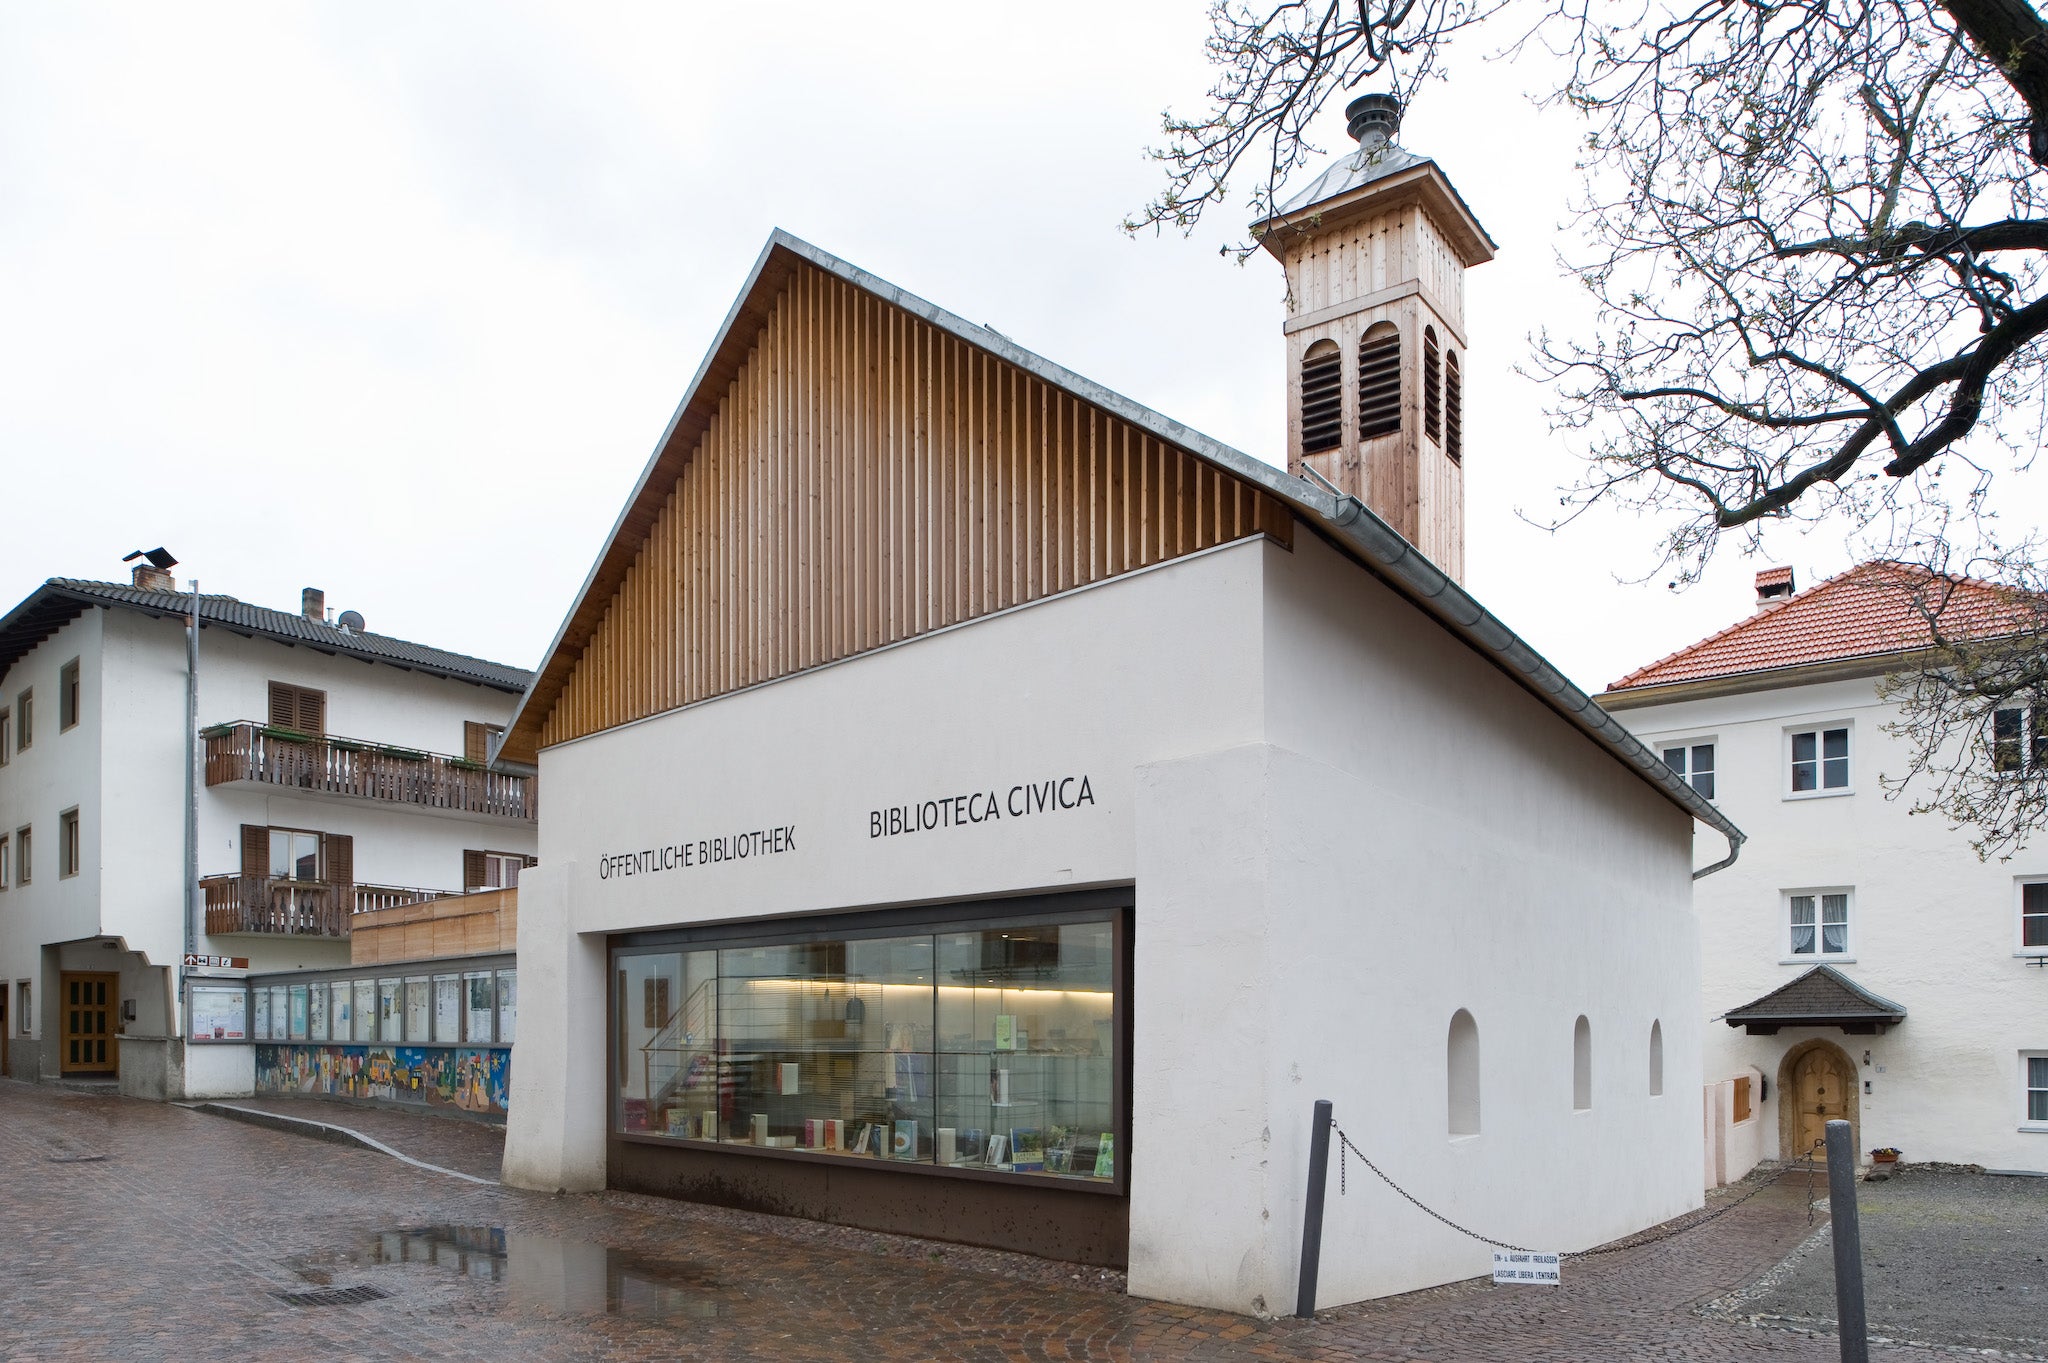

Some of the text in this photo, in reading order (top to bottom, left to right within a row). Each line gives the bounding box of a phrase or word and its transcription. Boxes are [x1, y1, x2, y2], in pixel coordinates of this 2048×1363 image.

[870, 774, 1095, 839] BIBLIOTECA CIVICA
[599, 825, 796, 880] ÖFFENTLICHE BIBLIOTHEK
[1495, 1270, 1517, 1278] LASCIARE
[1518, 1270, 1534, 1279] LIBERA
[1533, 1255, 1558, 1264] FREILASSEN
